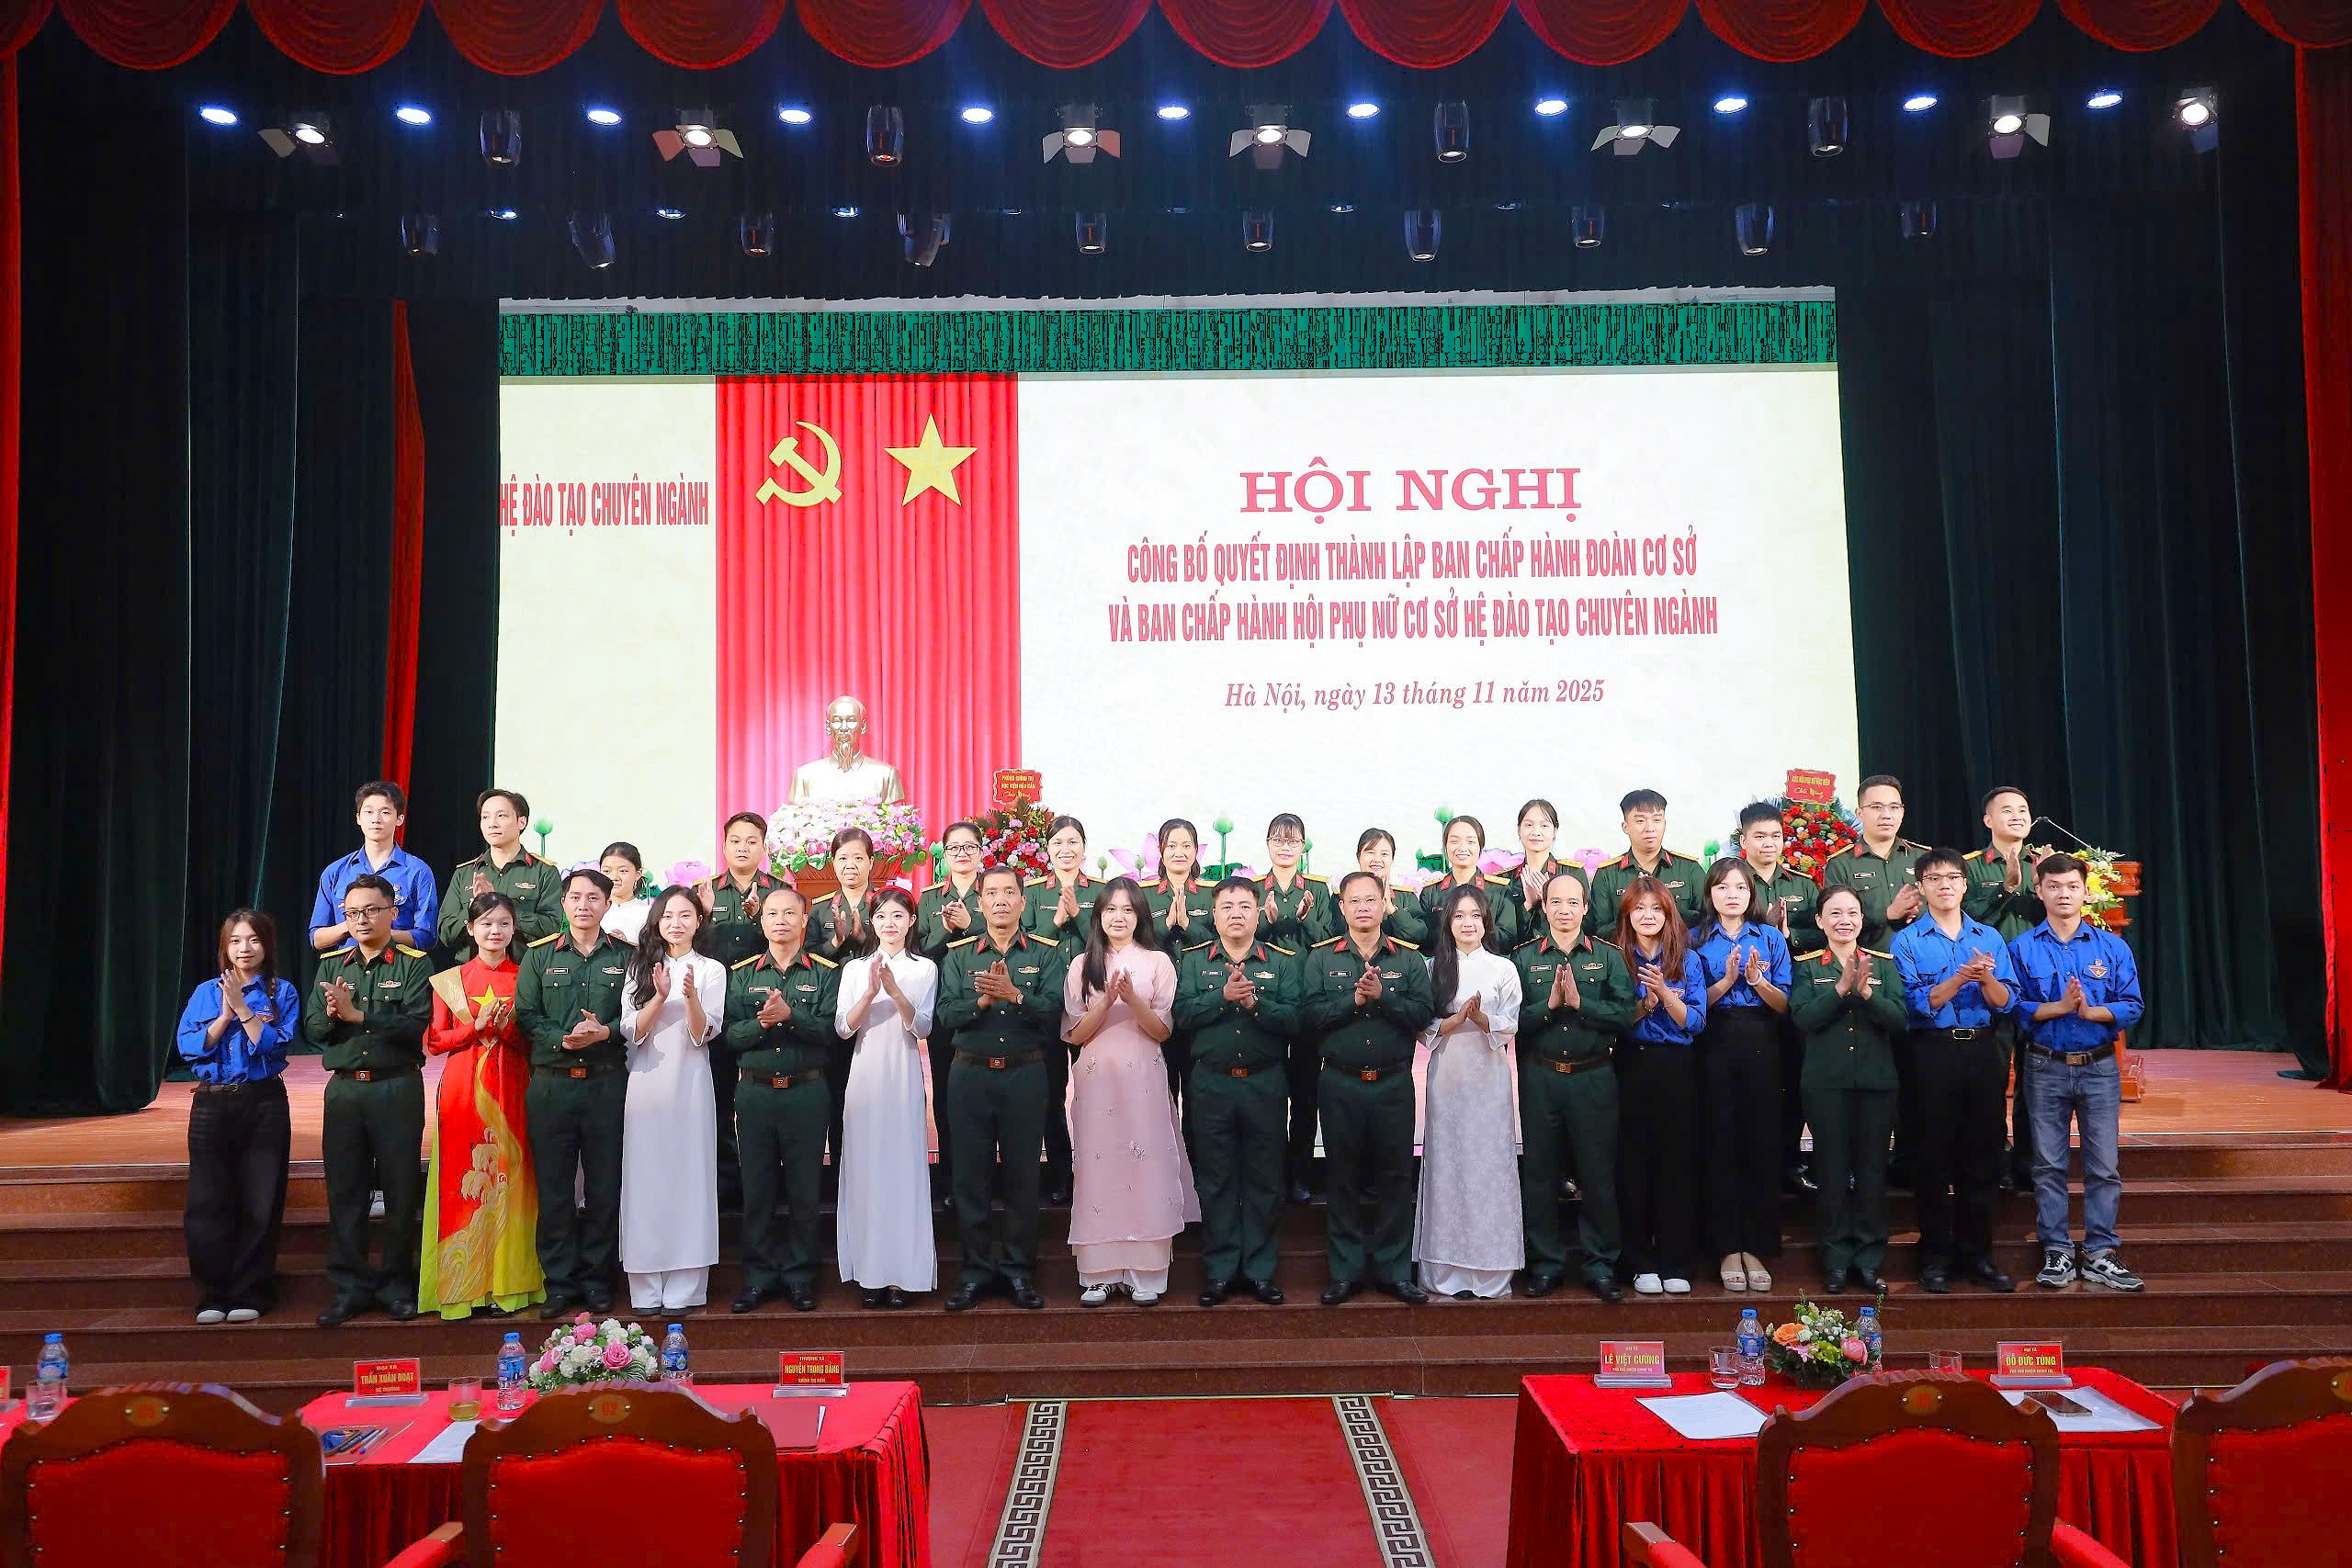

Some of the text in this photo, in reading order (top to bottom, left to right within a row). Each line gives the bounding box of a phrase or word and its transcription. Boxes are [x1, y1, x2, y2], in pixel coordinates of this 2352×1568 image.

[500, 473, 708, 536] HỆ ĐÀO TẠO CHUYÊN NGÀNH
[1240, 457, 1580, 524] HỘI NGHỊ
[1128, 525, 1696, 588] CÔNG BỐ QUYẾT ĐỊNH THÀNH LẬP BAN CHẤP HÀNH ĐOÀN CƠ SỞ
[1109, 587, 1717, 647] VÀ BAN CHẤP HÀNH HỘI PHỤ NỮ CƠ SỞ HỆ ĐÀO TẠO CHUYÊN NGÀNH
[1225, 678, 1604, 713] Hà Nội, ngày 13 tháng 11 năm 2025
[1604, 1352, 1660, 1366] LÊ VIỆT CƯỜNG
[2036, 1354, 2056, 1366] TÙNG
